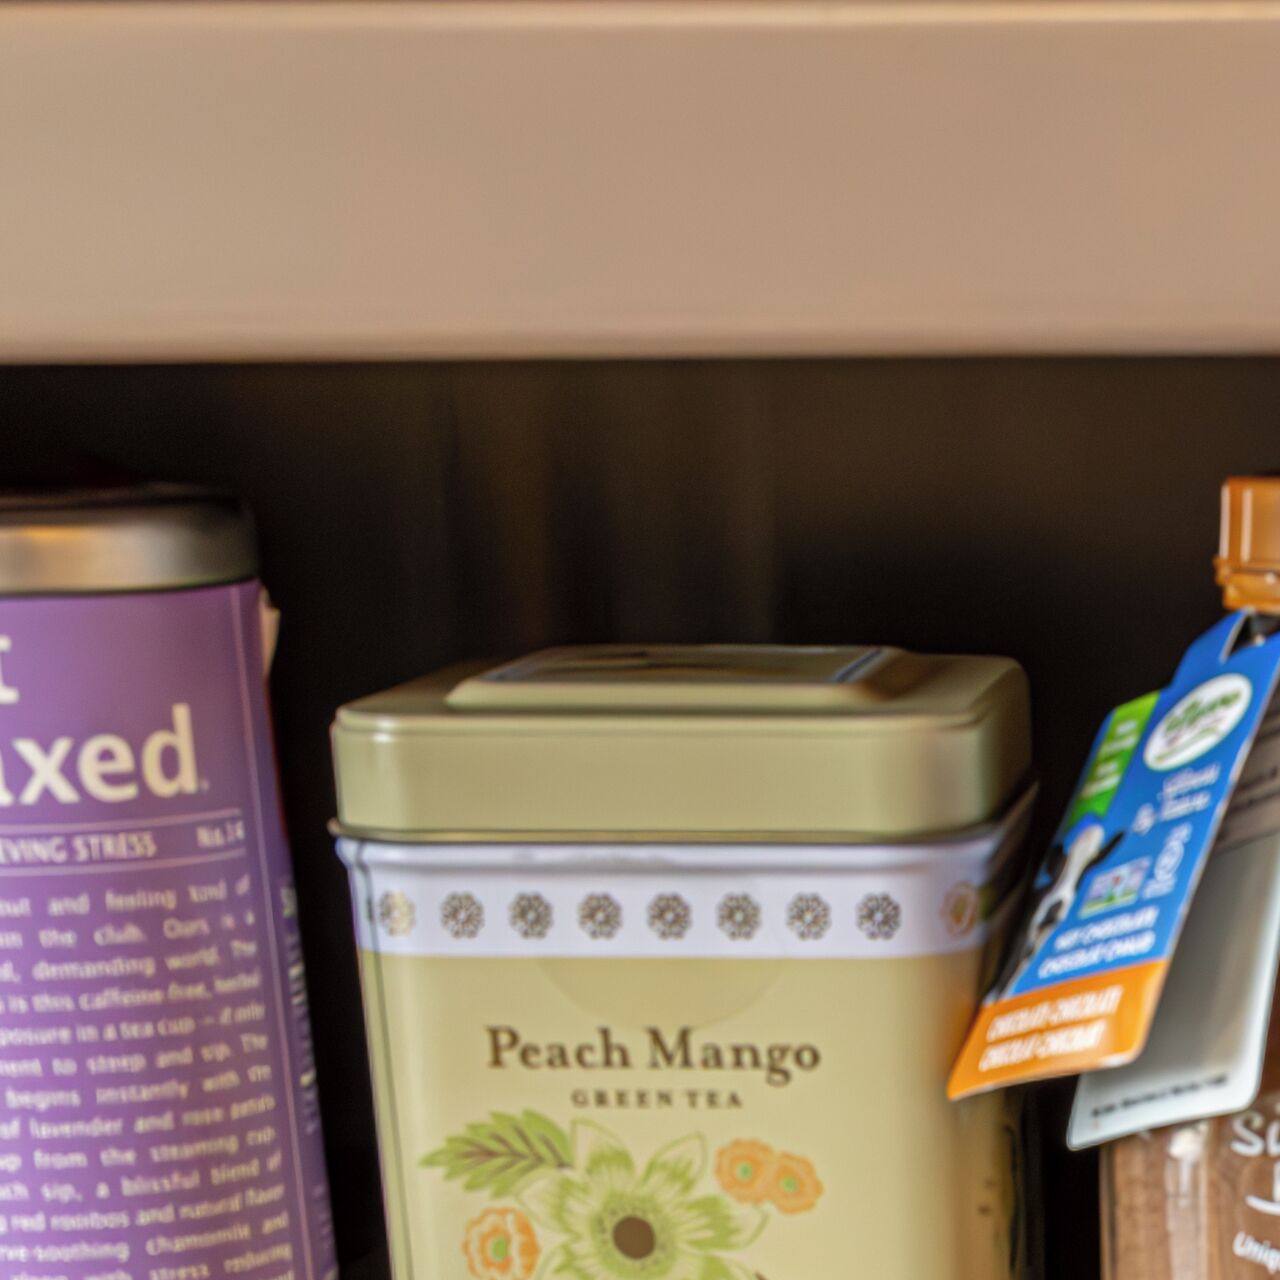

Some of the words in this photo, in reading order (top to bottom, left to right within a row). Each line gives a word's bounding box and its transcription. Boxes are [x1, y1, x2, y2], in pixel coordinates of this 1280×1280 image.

[73, 832, 157, 862] STRESS
[485, 1025, 633, 1071] Peach
[645, 1025, 822, 1088] Mango
[571, 1089, 675, 1109] GREEN
[686, 1090, 743, 1110] TEA
